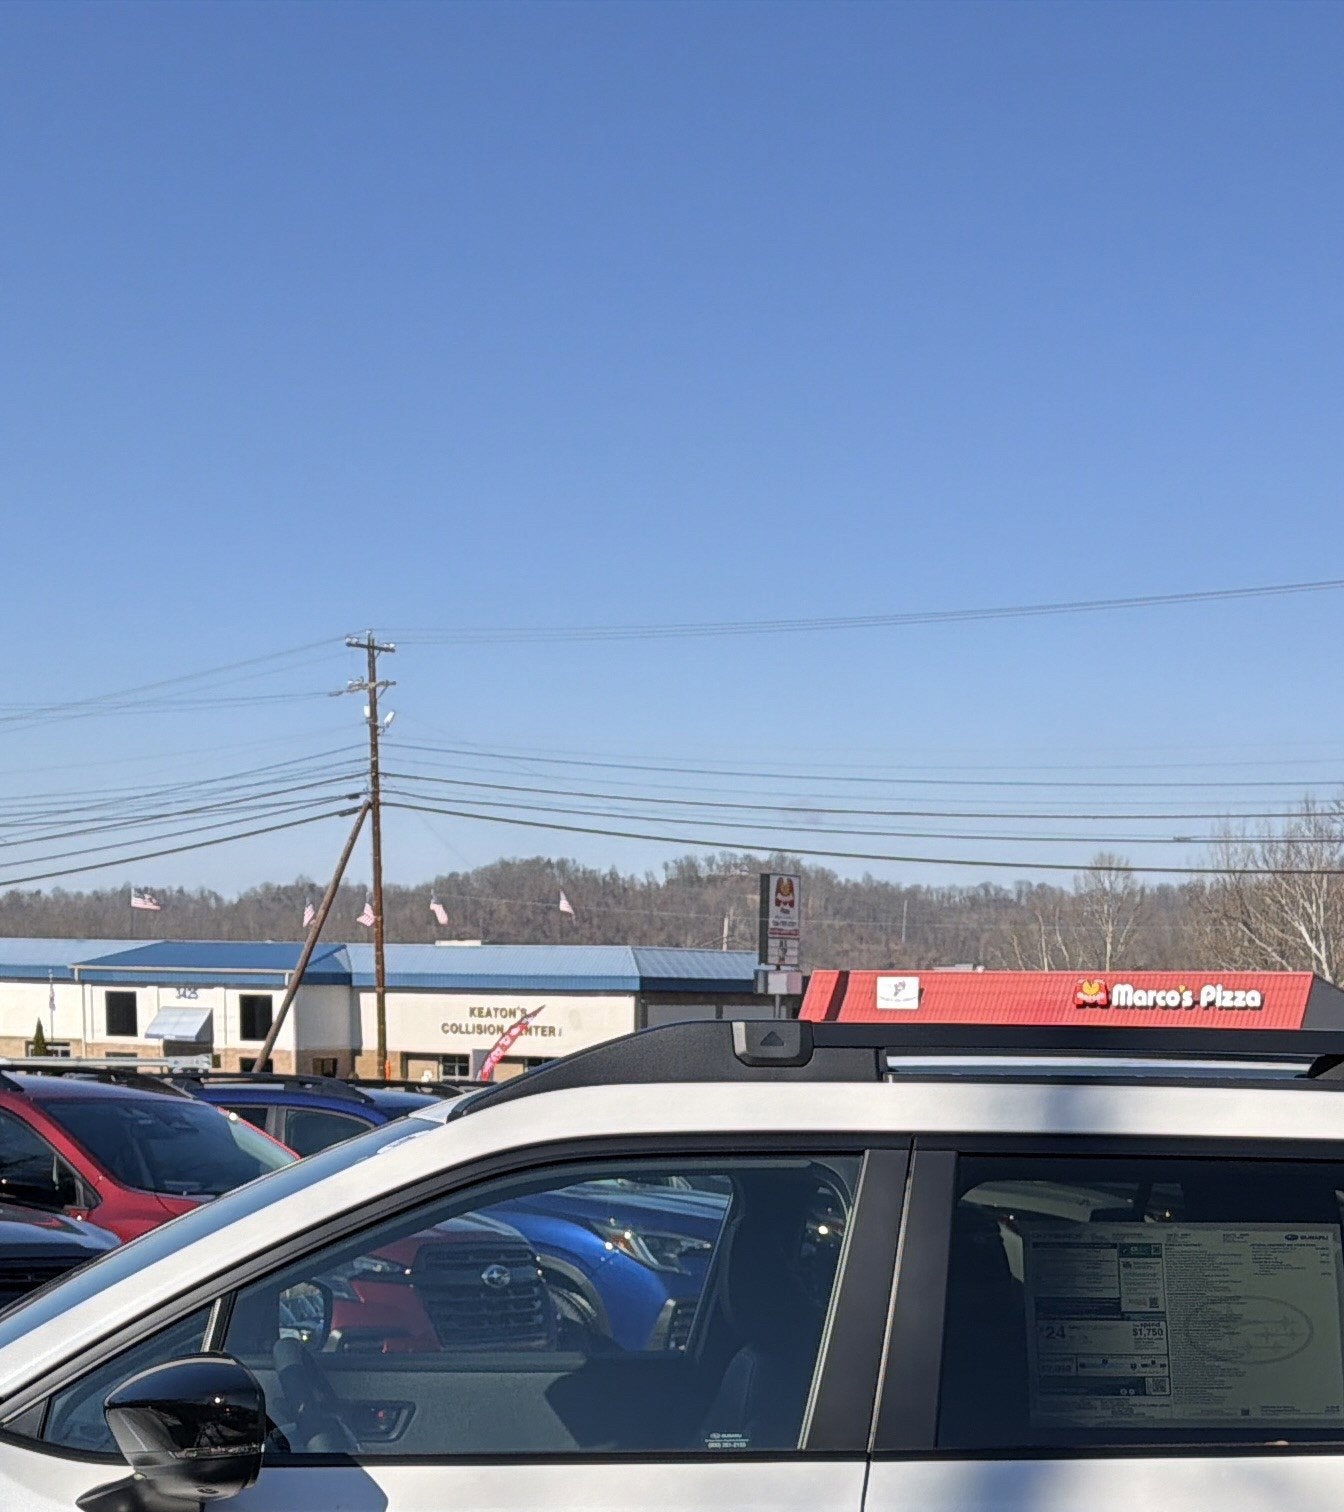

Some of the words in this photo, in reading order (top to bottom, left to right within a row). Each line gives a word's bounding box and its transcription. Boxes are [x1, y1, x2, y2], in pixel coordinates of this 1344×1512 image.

[1112, 983, 1193, 1007] Marco's
[1200, 984, 1262, 1007] Pizza
[469, 1006, 527, 1019] KEATON'S
[441, 1023, 504, 1036] COLLISION
